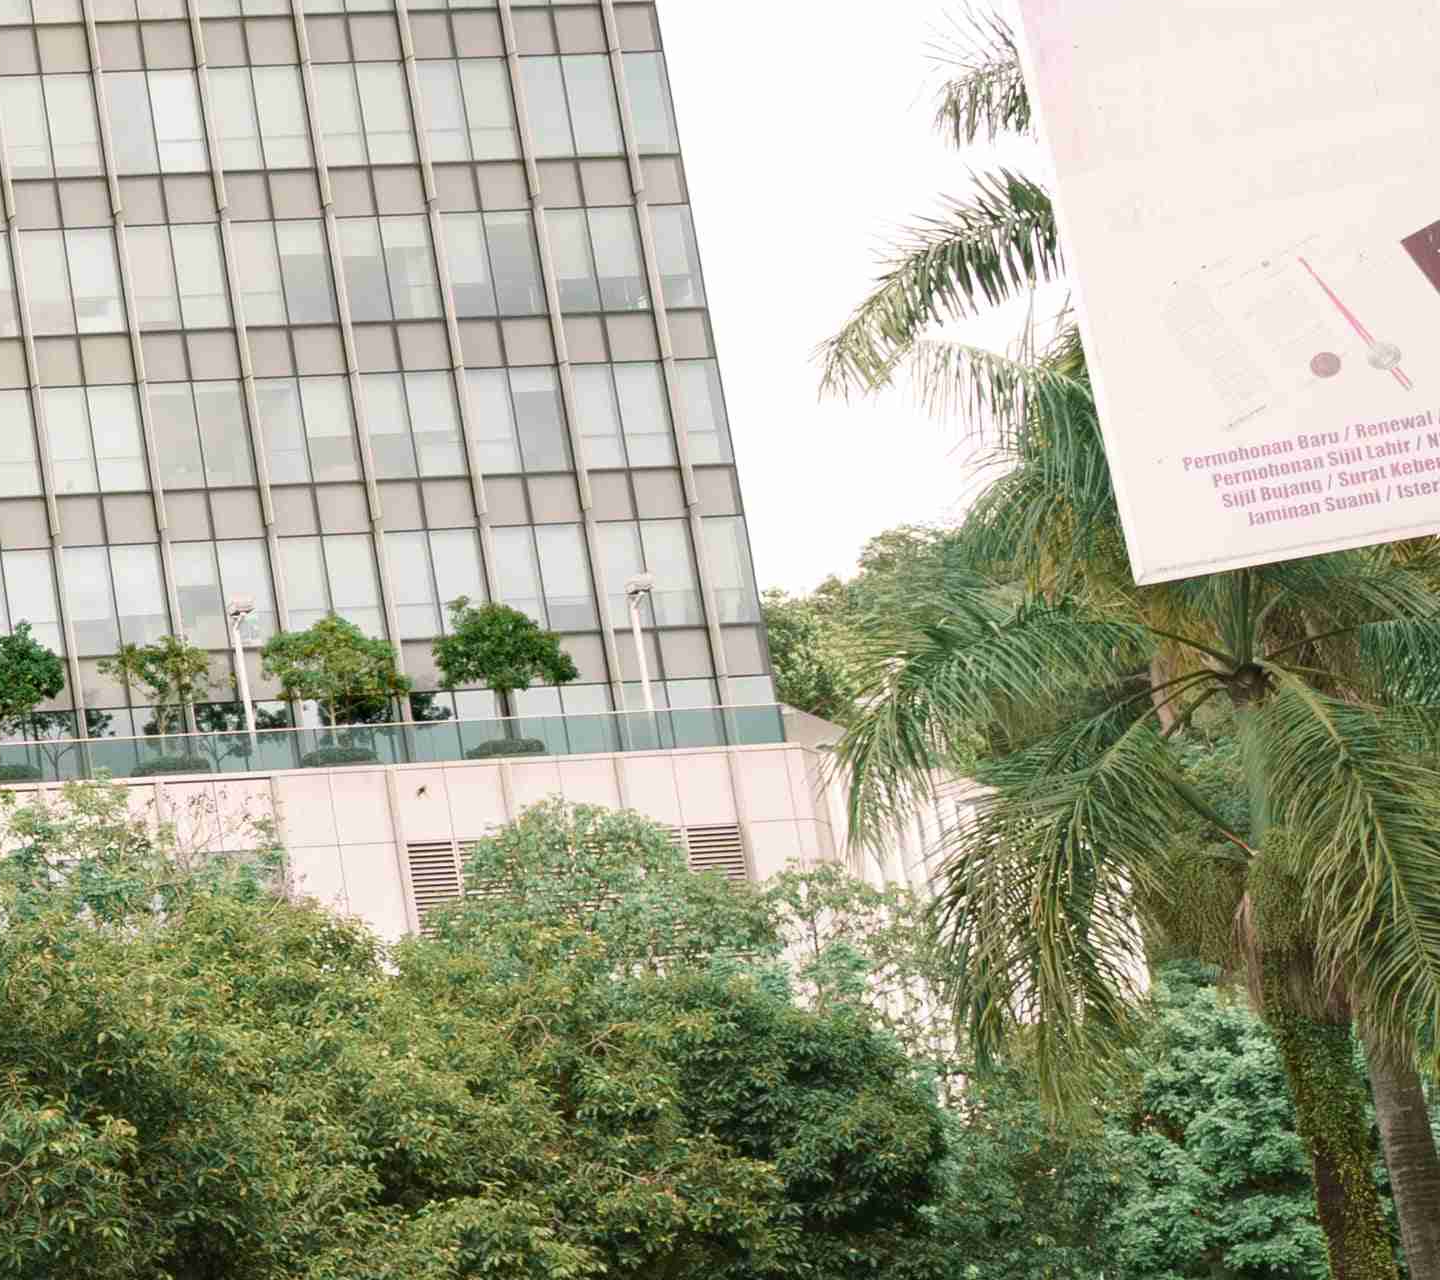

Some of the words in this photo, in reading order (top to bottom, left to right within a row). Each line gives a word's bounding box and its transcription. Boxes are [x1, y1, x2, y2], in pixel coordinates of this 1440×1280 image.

[1182, 438, 1294, 471] Permohonan
[1297, 431, 1340, 450] Baru
[1355, 410, 1433, 439] Renewal
[1212, 455, 1324, 488] Permohonan
[1328, 446, 1363, 468] Sijil
[1366, 439, 1410, 459] Lahir
[1222, 488, 1256, 508] Sijil
[1261, 478, 1323, 502] Bujang
[1337, 465, 1387, 487] Surat
[1247, 500, 1321, 526] Jaminan
[1325, 489, 1381, 513] Suami
